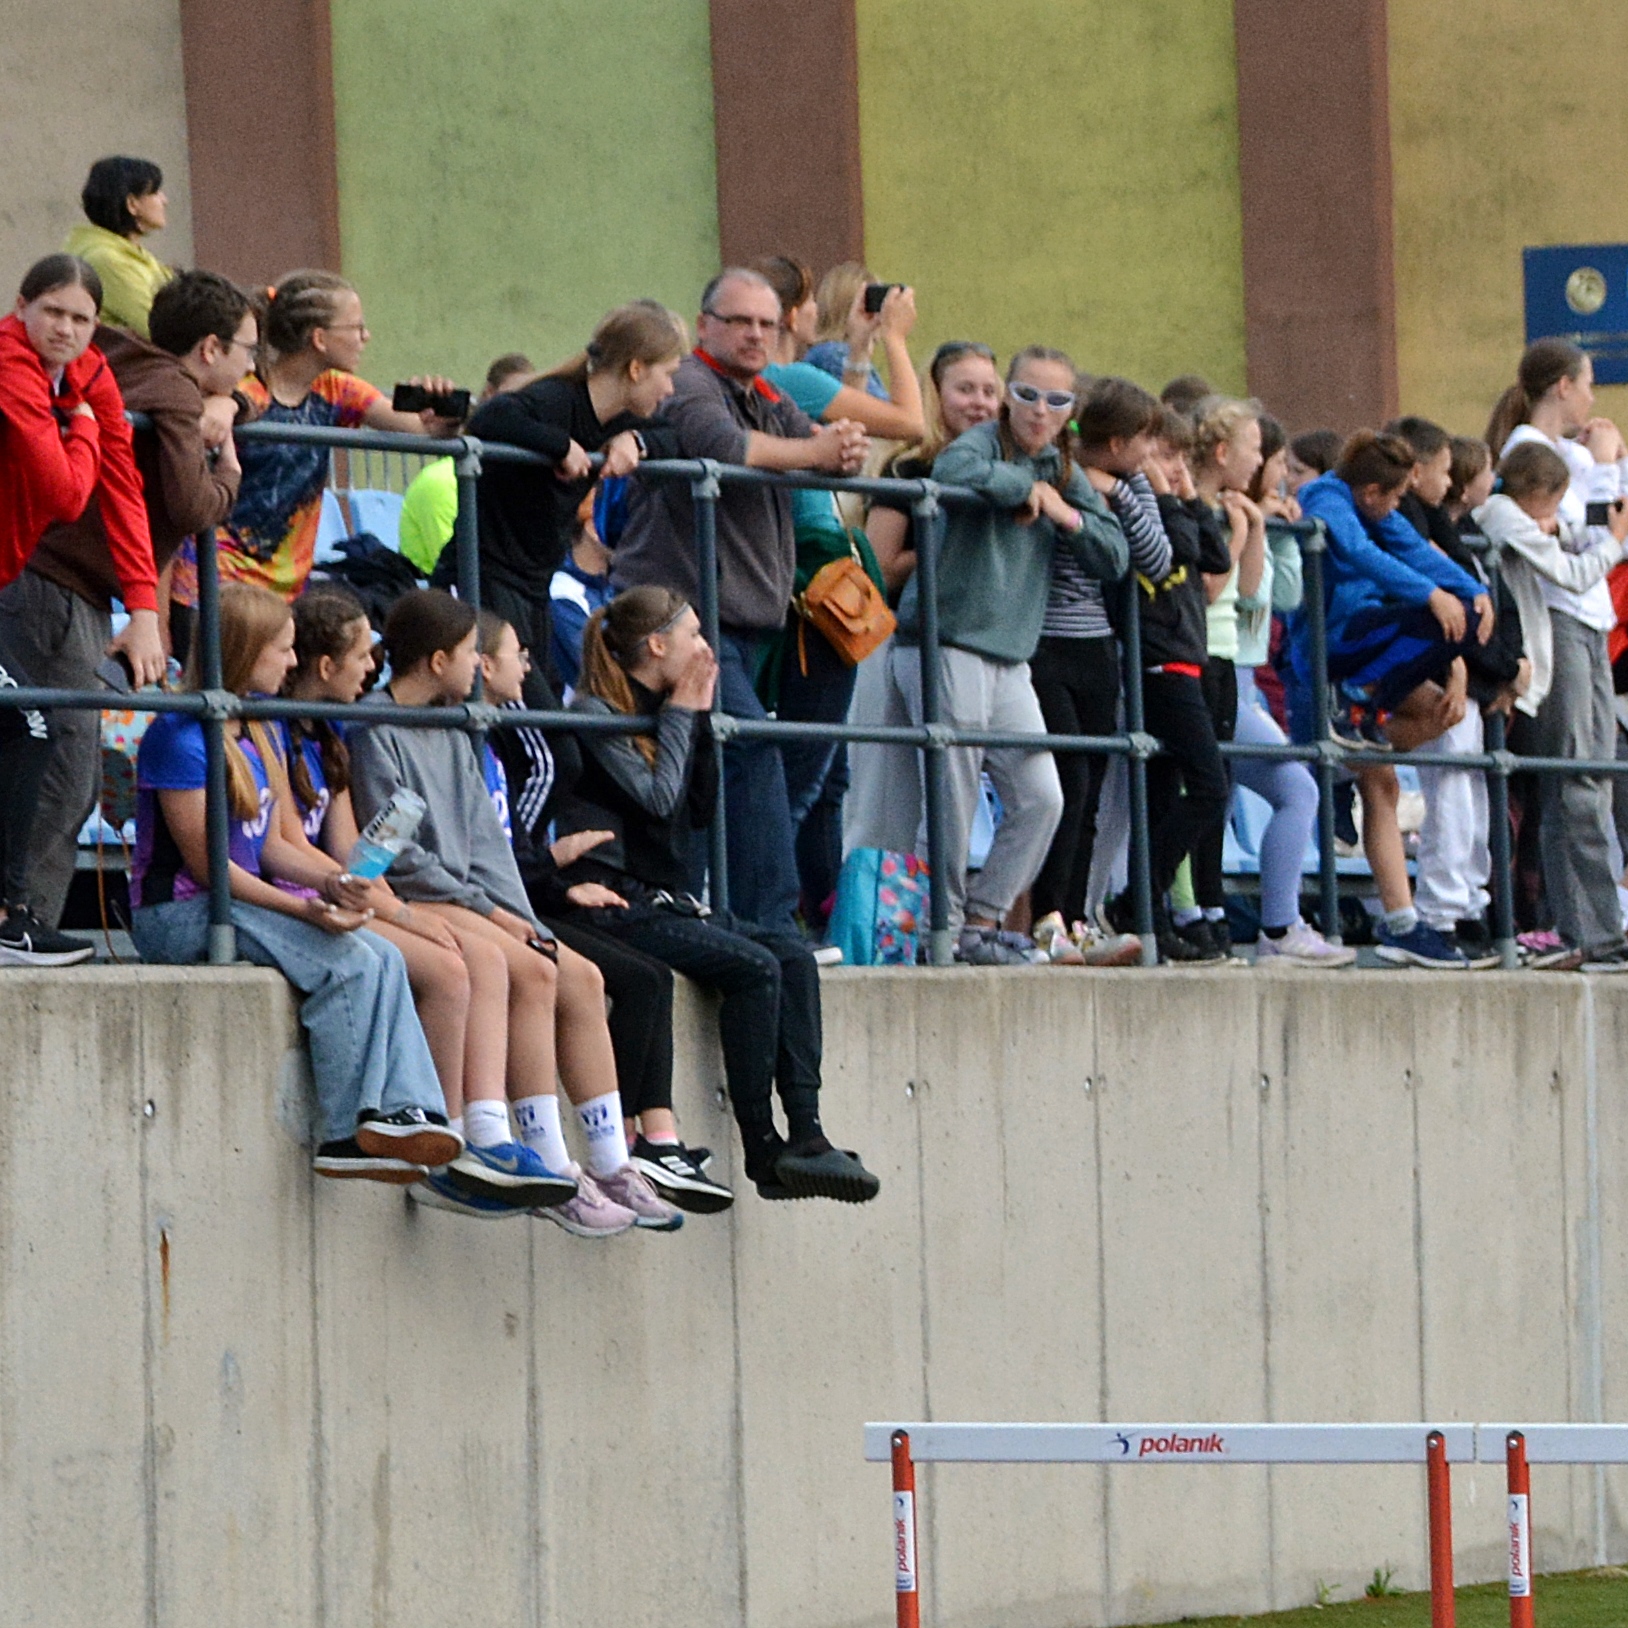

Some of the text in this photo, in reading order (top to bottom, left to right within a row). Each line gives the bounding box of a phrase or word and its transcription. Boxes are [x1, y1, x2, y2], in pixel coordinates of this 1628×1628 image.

[1139, 1433, 1224, 1457] polanik
[894, 1518, 909, 1573] polanik
[1509, 1522, 1523, 1577] polanik
